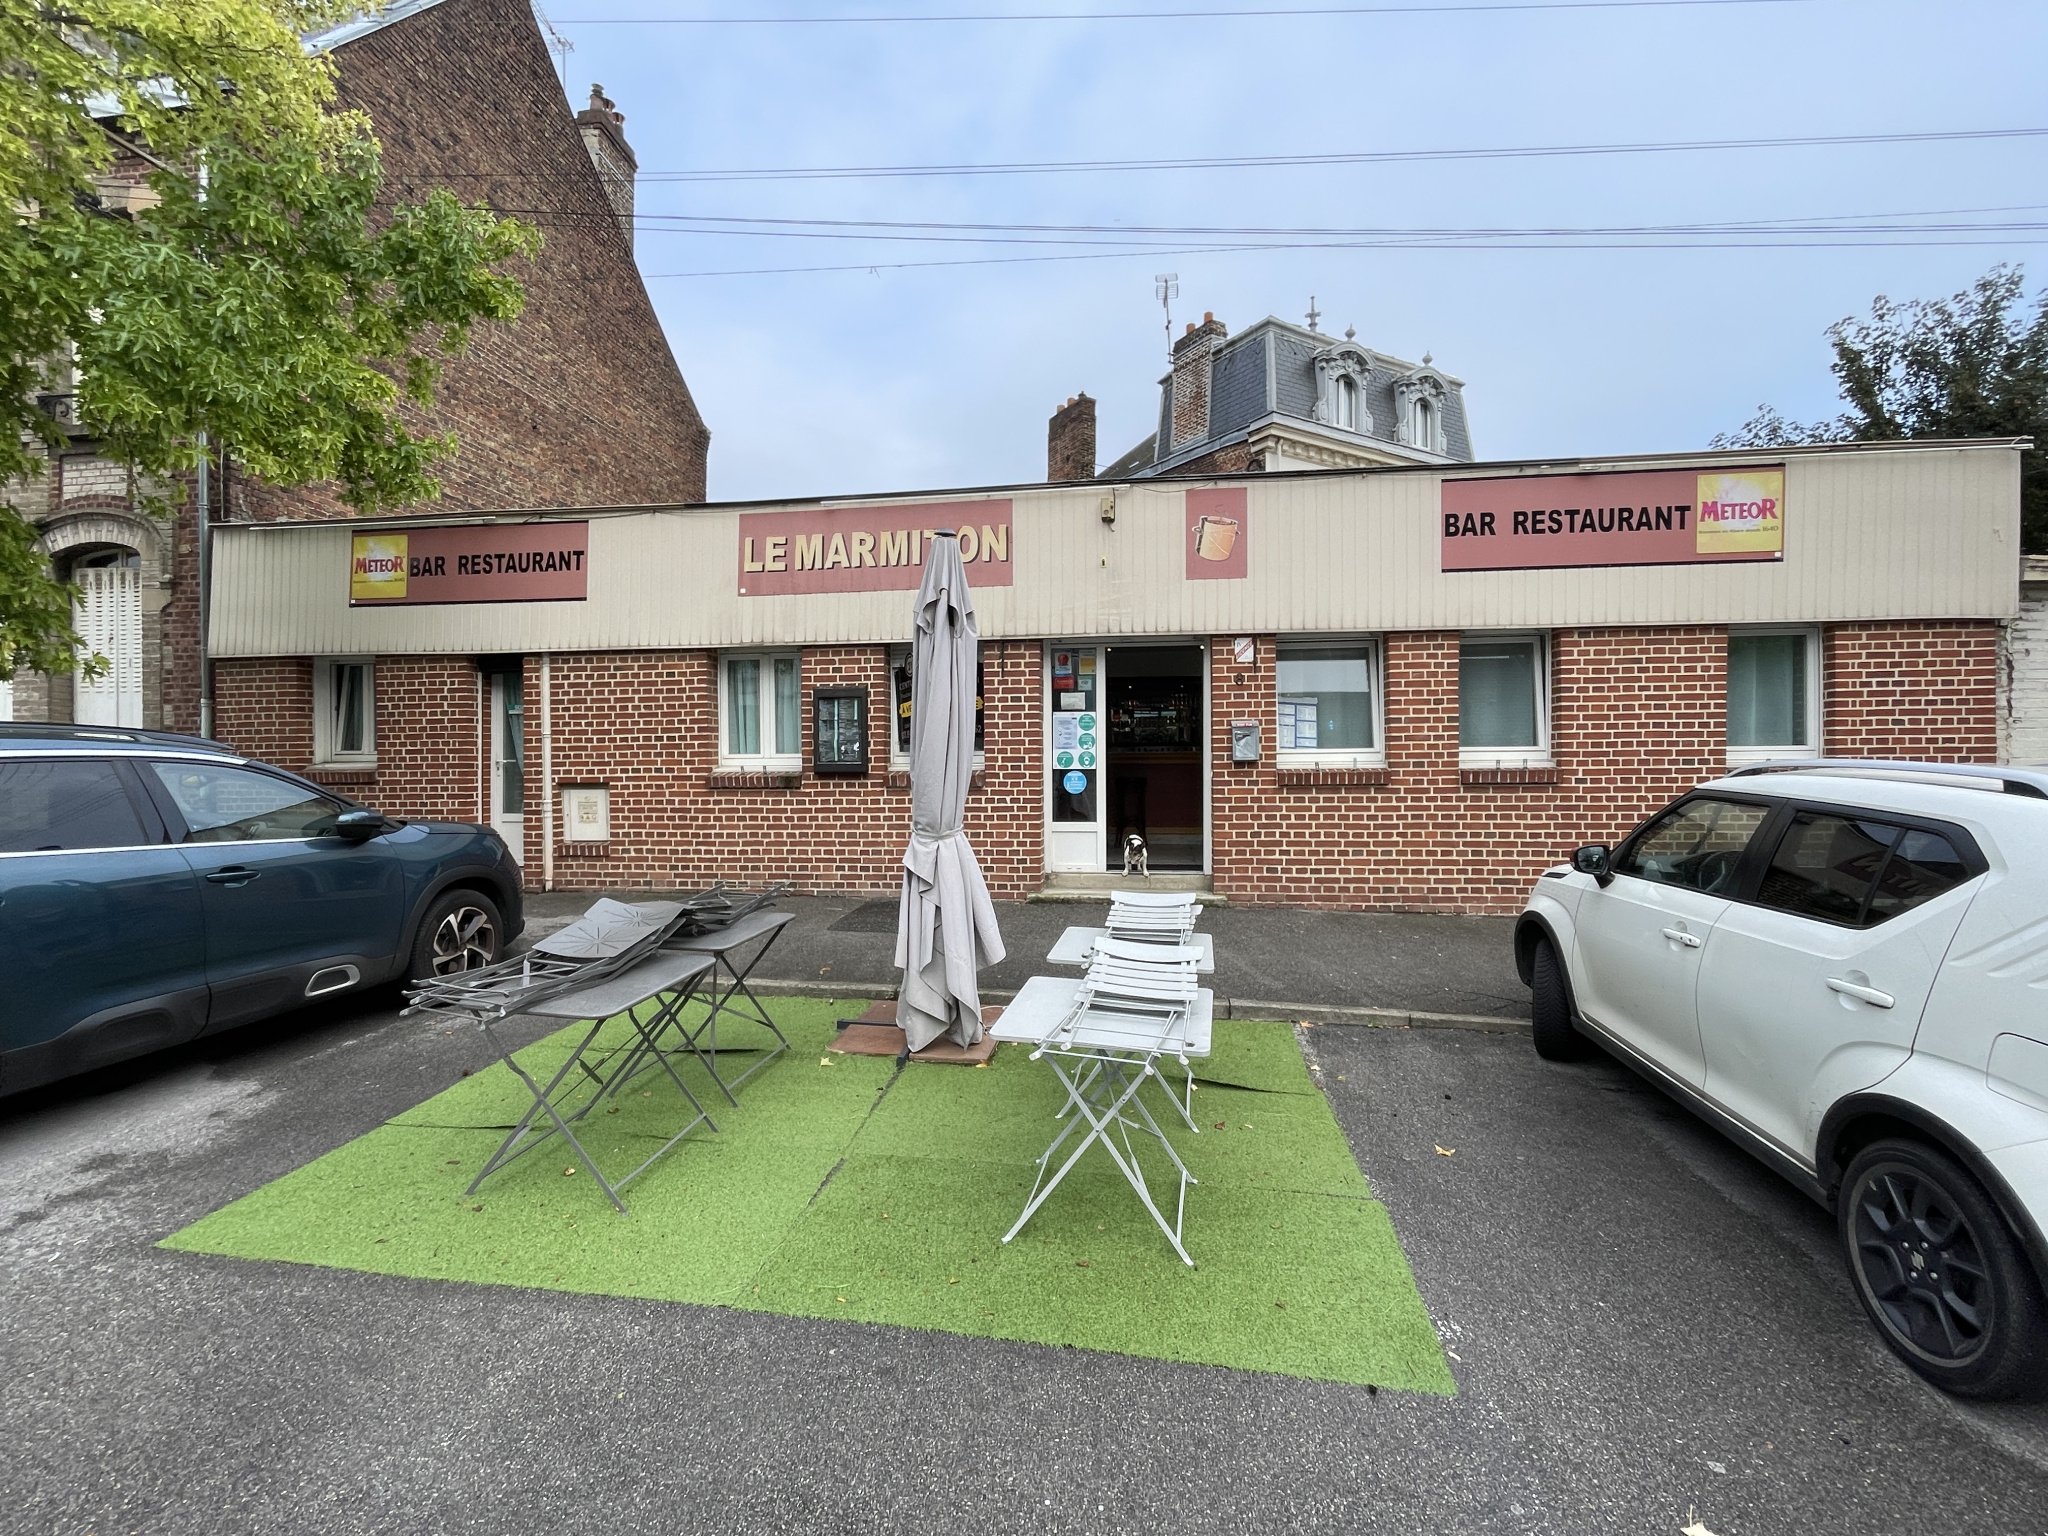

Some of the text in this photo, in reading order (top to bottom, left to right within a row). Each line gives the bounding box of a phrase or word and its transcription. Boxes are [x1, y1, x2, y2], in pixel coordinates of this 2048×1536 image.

[1444, 505, 1691, 538] BAR RESTAURANT
[1699, 498, 1778, 522] METEOR
[744, 524, 1009, 573] LE MARMION
[354, 556, 405, 574] METEOR
[410, 550, 585, 578] BAR RESTAURANT
